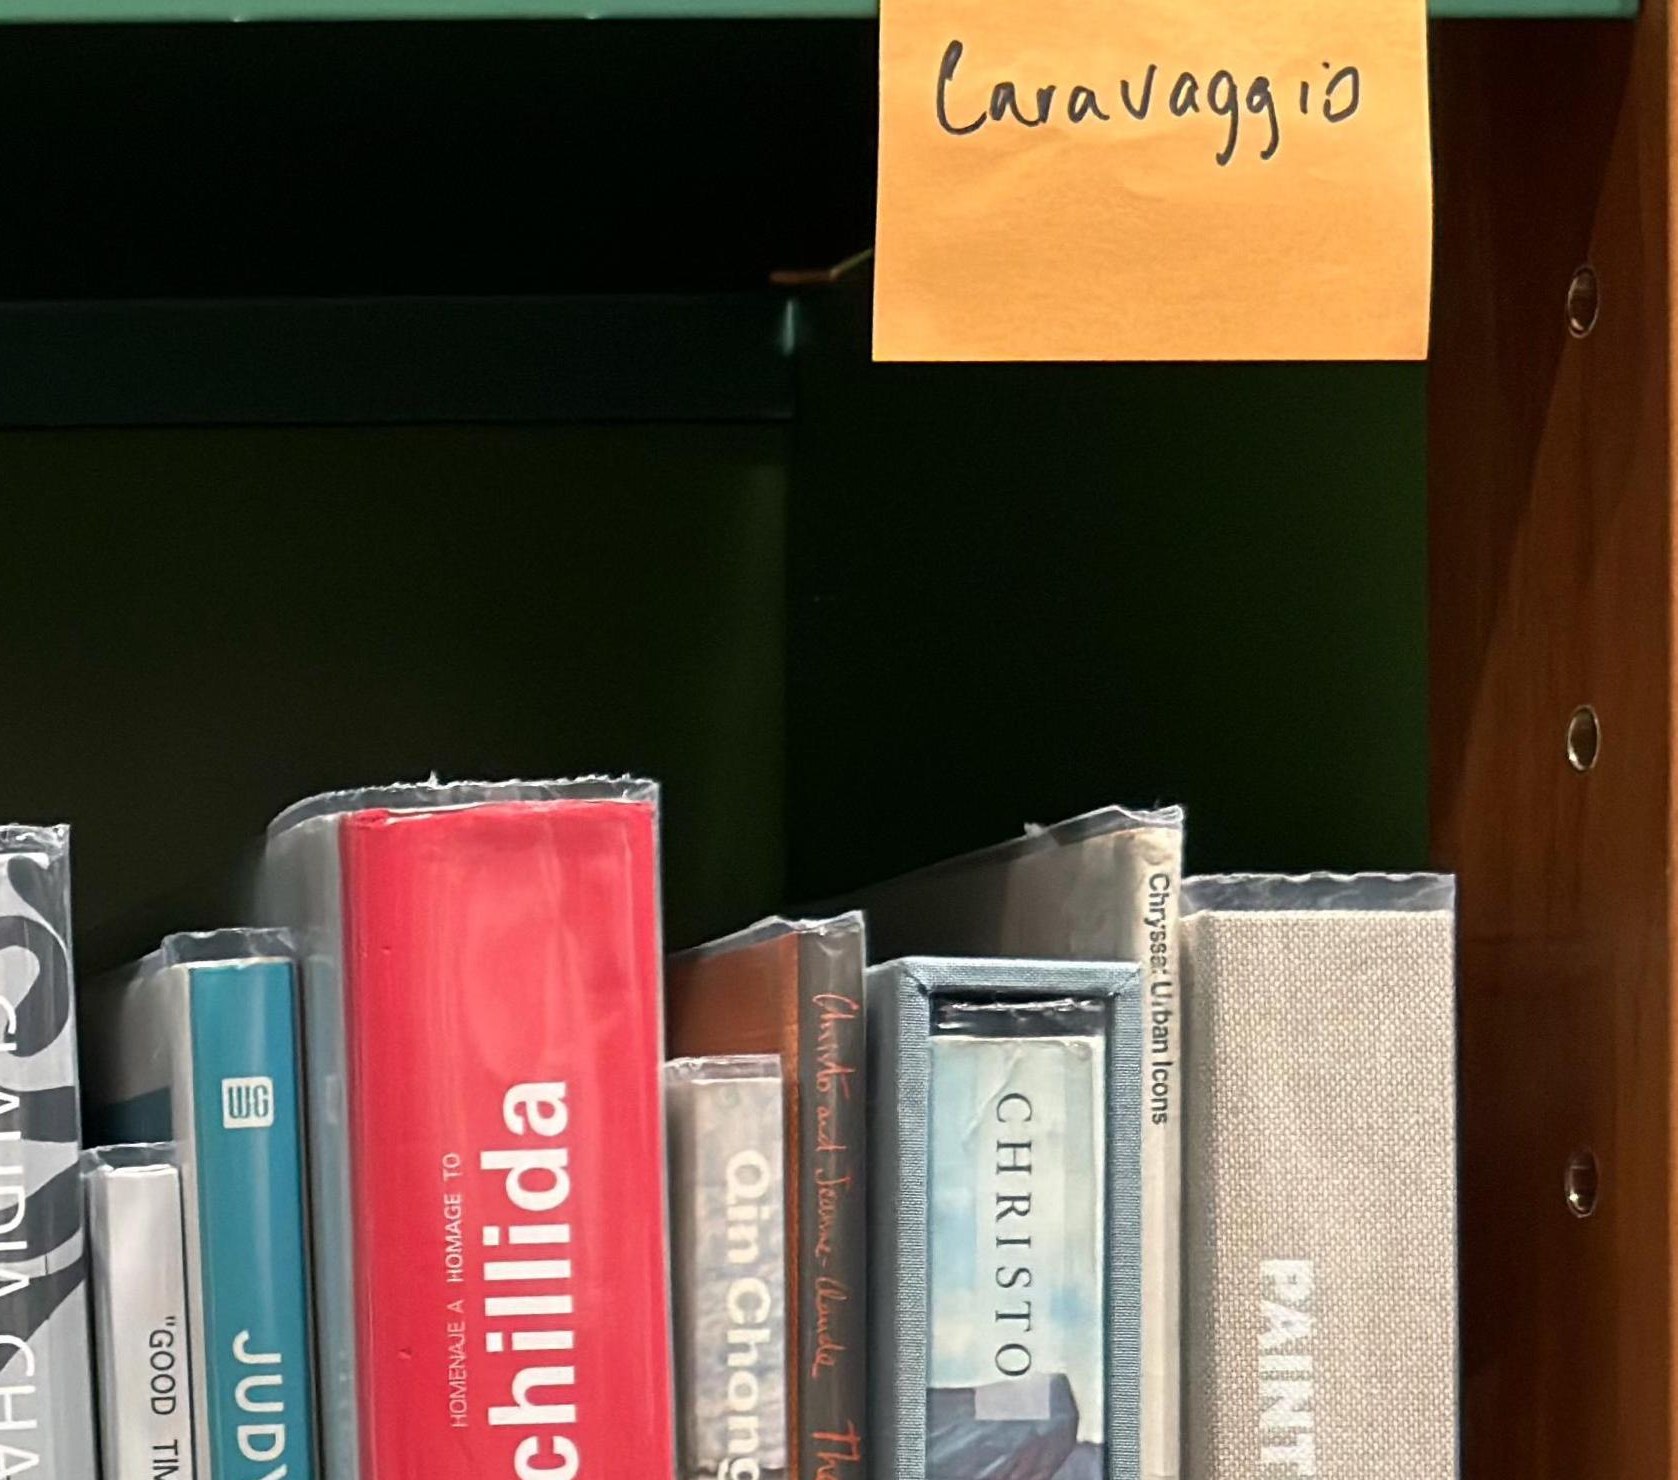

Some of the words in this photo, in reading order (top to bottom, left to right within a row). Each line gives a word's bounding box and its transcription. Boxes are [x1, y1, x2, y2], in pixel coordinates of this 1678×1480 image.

[935, 39, 1360, 166] Caravaggio
[443, 1192, 465, 1292] HOMAGE
[724, 1149, 771, 1265] Qin
[994, 1092, 1032, 1379] CHRISTO
[447, 1319, 469, 1428] HOMENAJE
